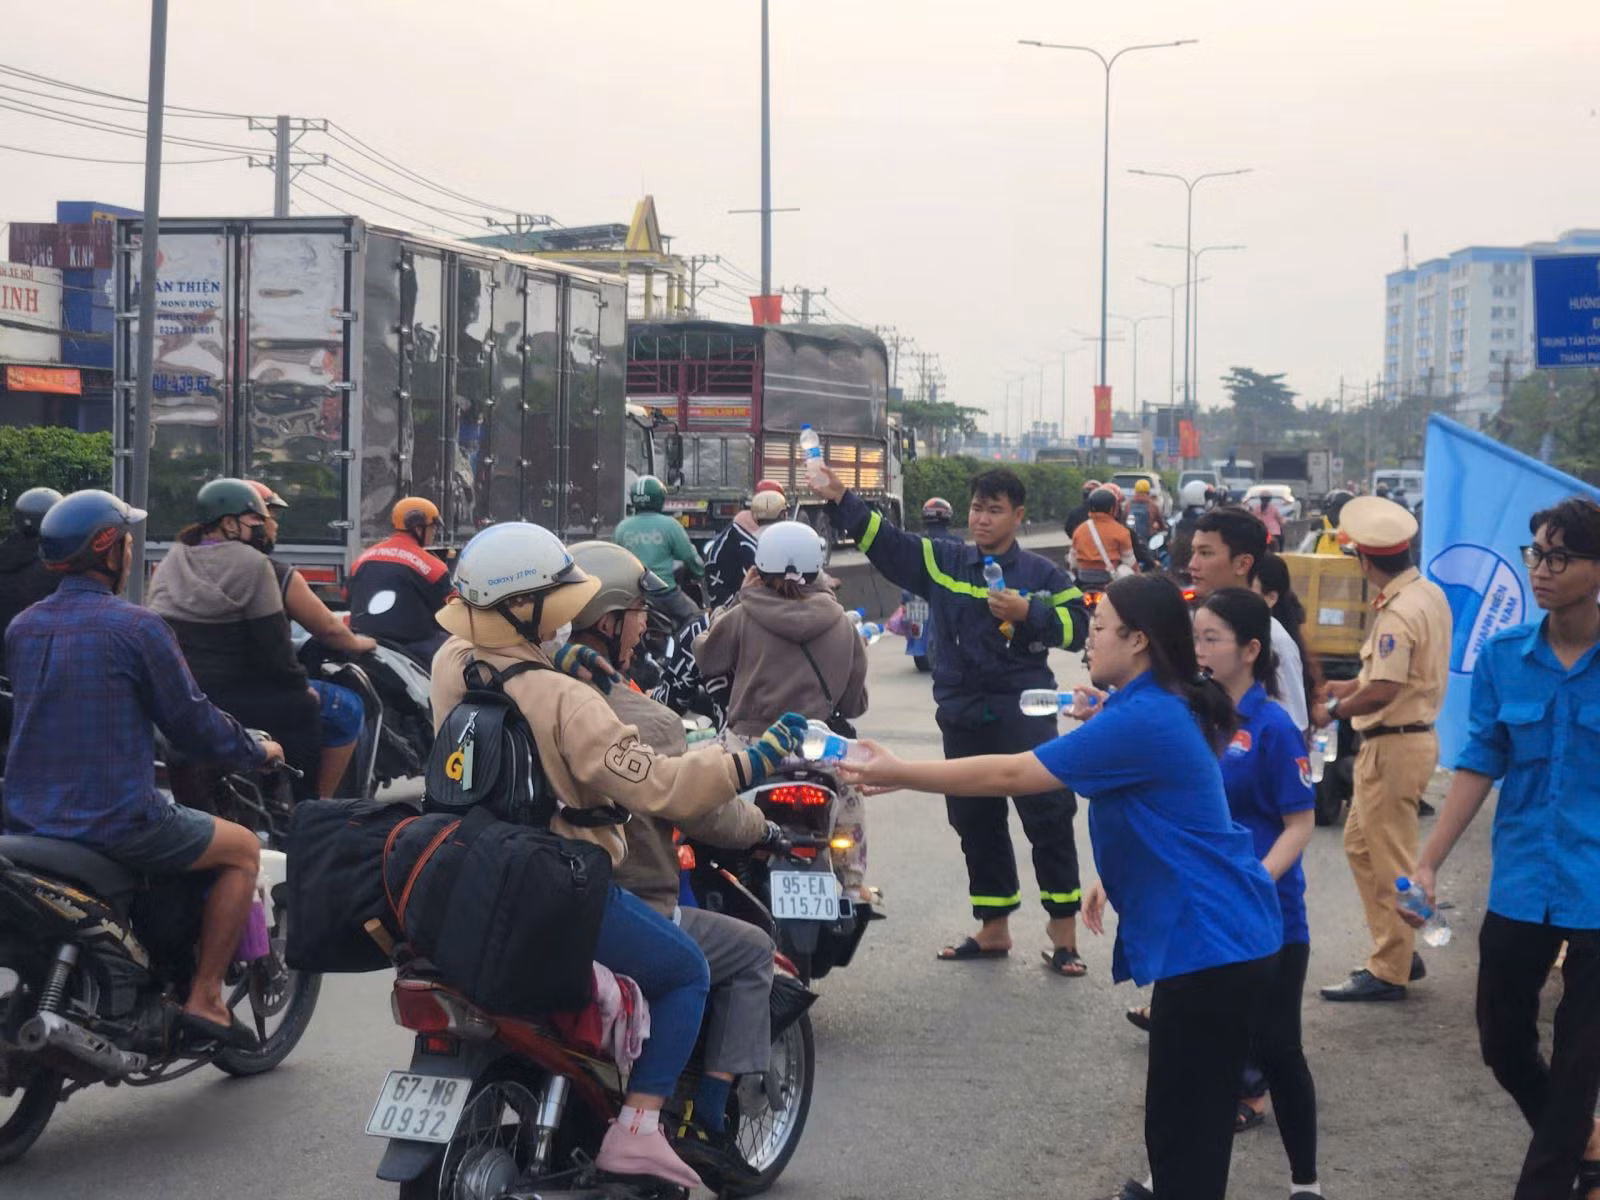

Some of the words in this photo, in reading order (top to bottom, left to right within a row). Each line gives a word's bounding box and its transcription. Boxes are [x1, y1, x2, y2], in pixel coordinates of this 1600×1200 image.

[623, 528, 664, 545] Grab
[487, 574, 514, 587] Galaxy
[778, 896, 834, 917] 115.70
[380, 1104, 447, 1137] 0932
